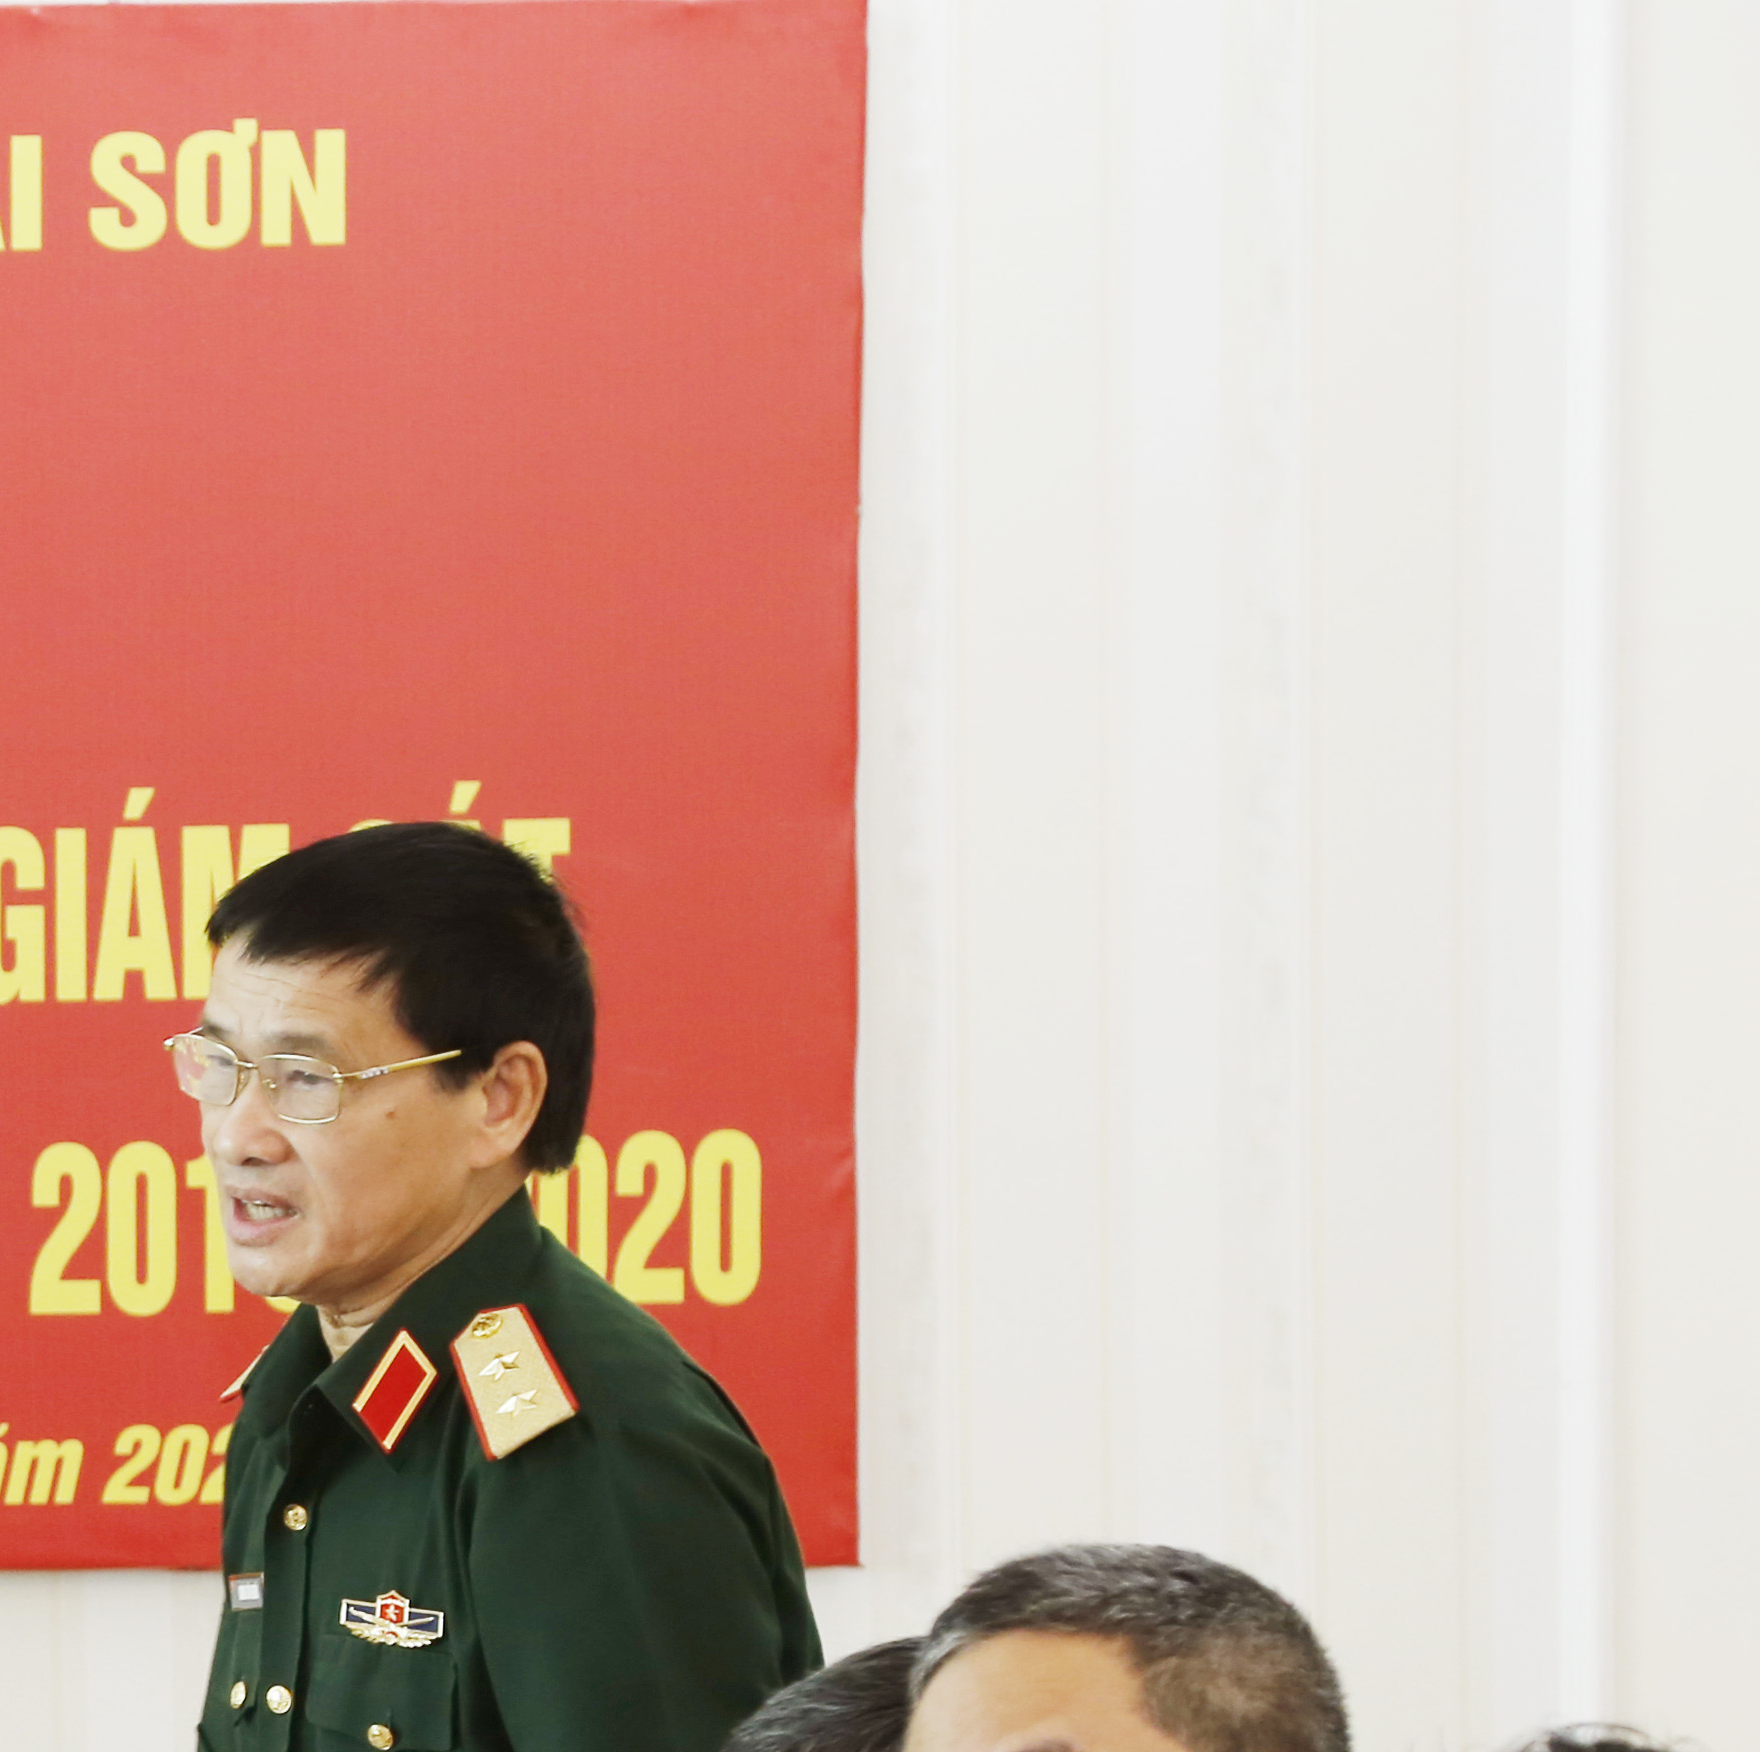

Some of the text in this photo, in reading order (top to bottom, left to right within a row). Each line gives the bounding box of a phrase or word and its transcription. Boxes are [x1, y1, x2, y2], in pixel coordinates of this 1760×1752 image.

[88, 117, 347, 252] SƠN
[29, 1140, 301, 1316] 201
[524, 1129, 762, 1306] 020
